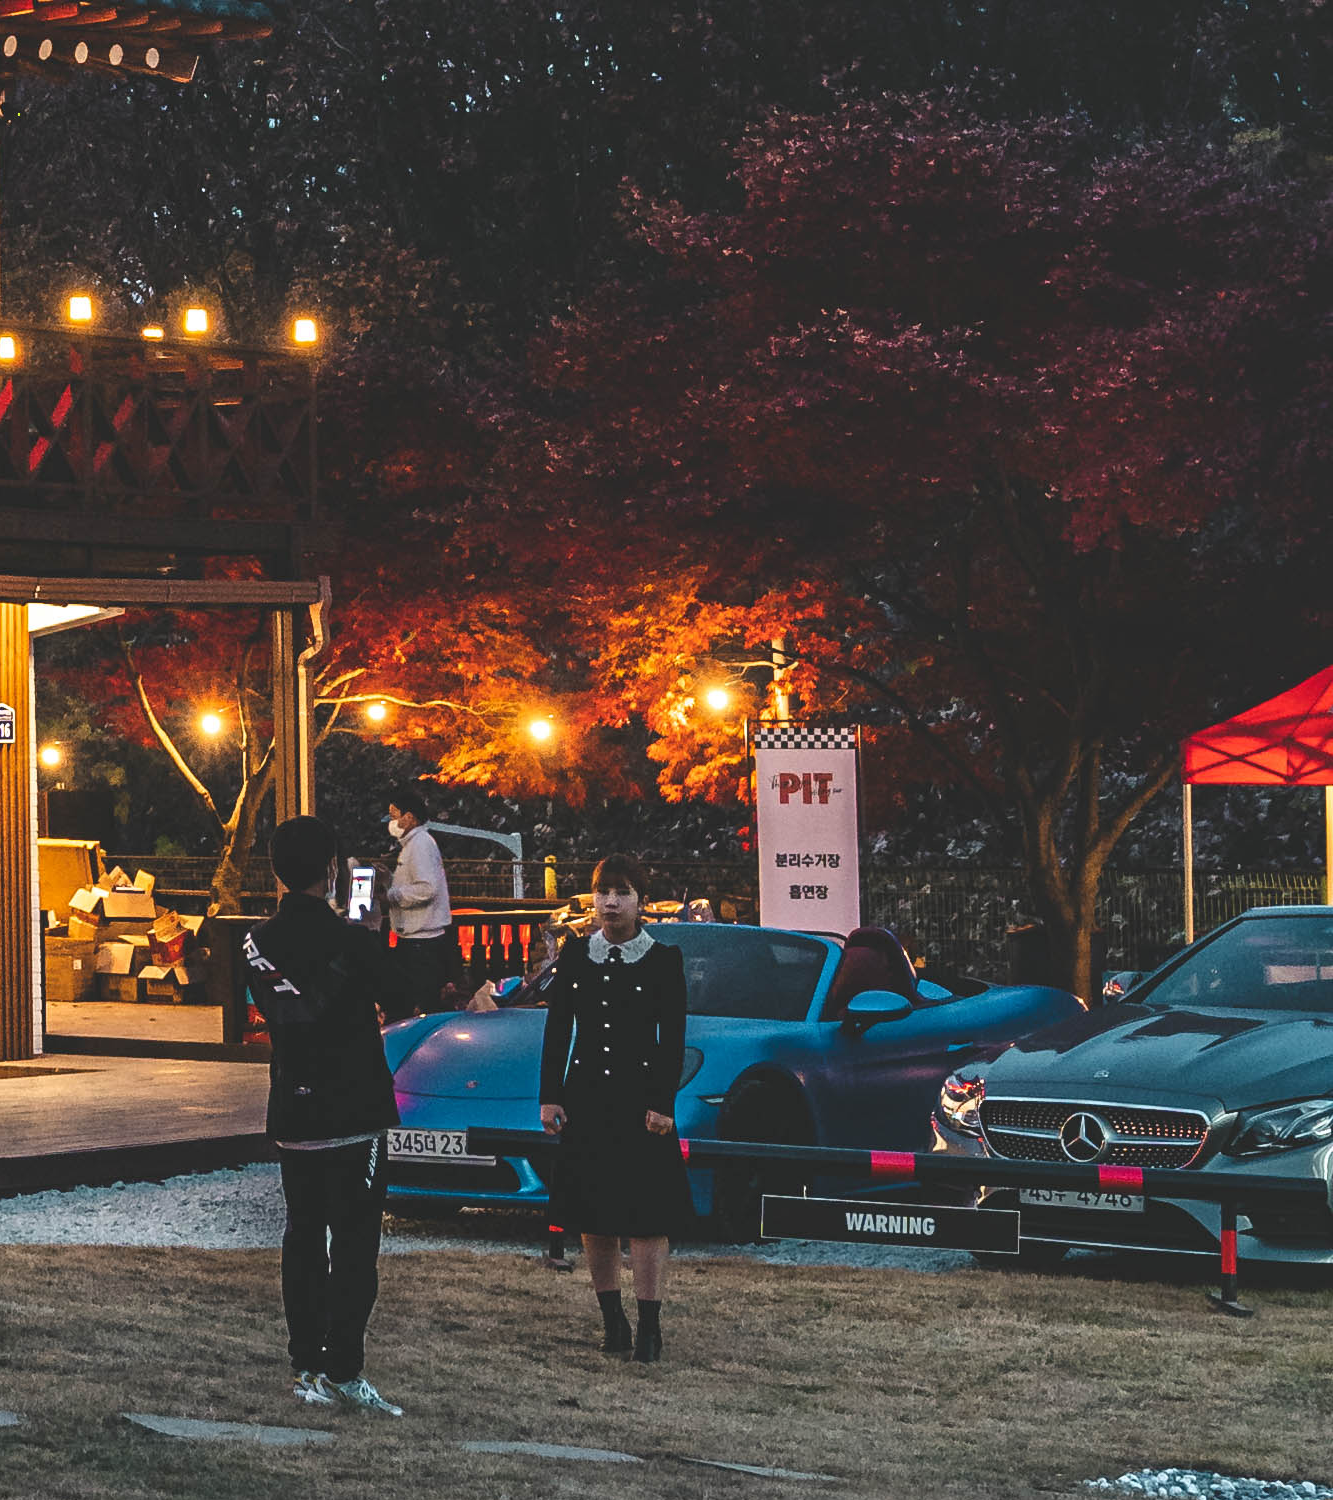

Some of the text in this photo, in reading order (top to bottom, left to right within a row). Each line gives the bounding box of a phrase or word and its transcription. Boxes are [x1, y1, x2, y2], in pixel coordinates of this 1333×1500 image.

[779, 773, 833, 804] PIT
[775, 853, 841, 868] 분리수거장
[789, 885, 829, 900] 흡연장
[440, 1134, 464, 1155] 23
[845, 1212, 935, 1236] WARNING
